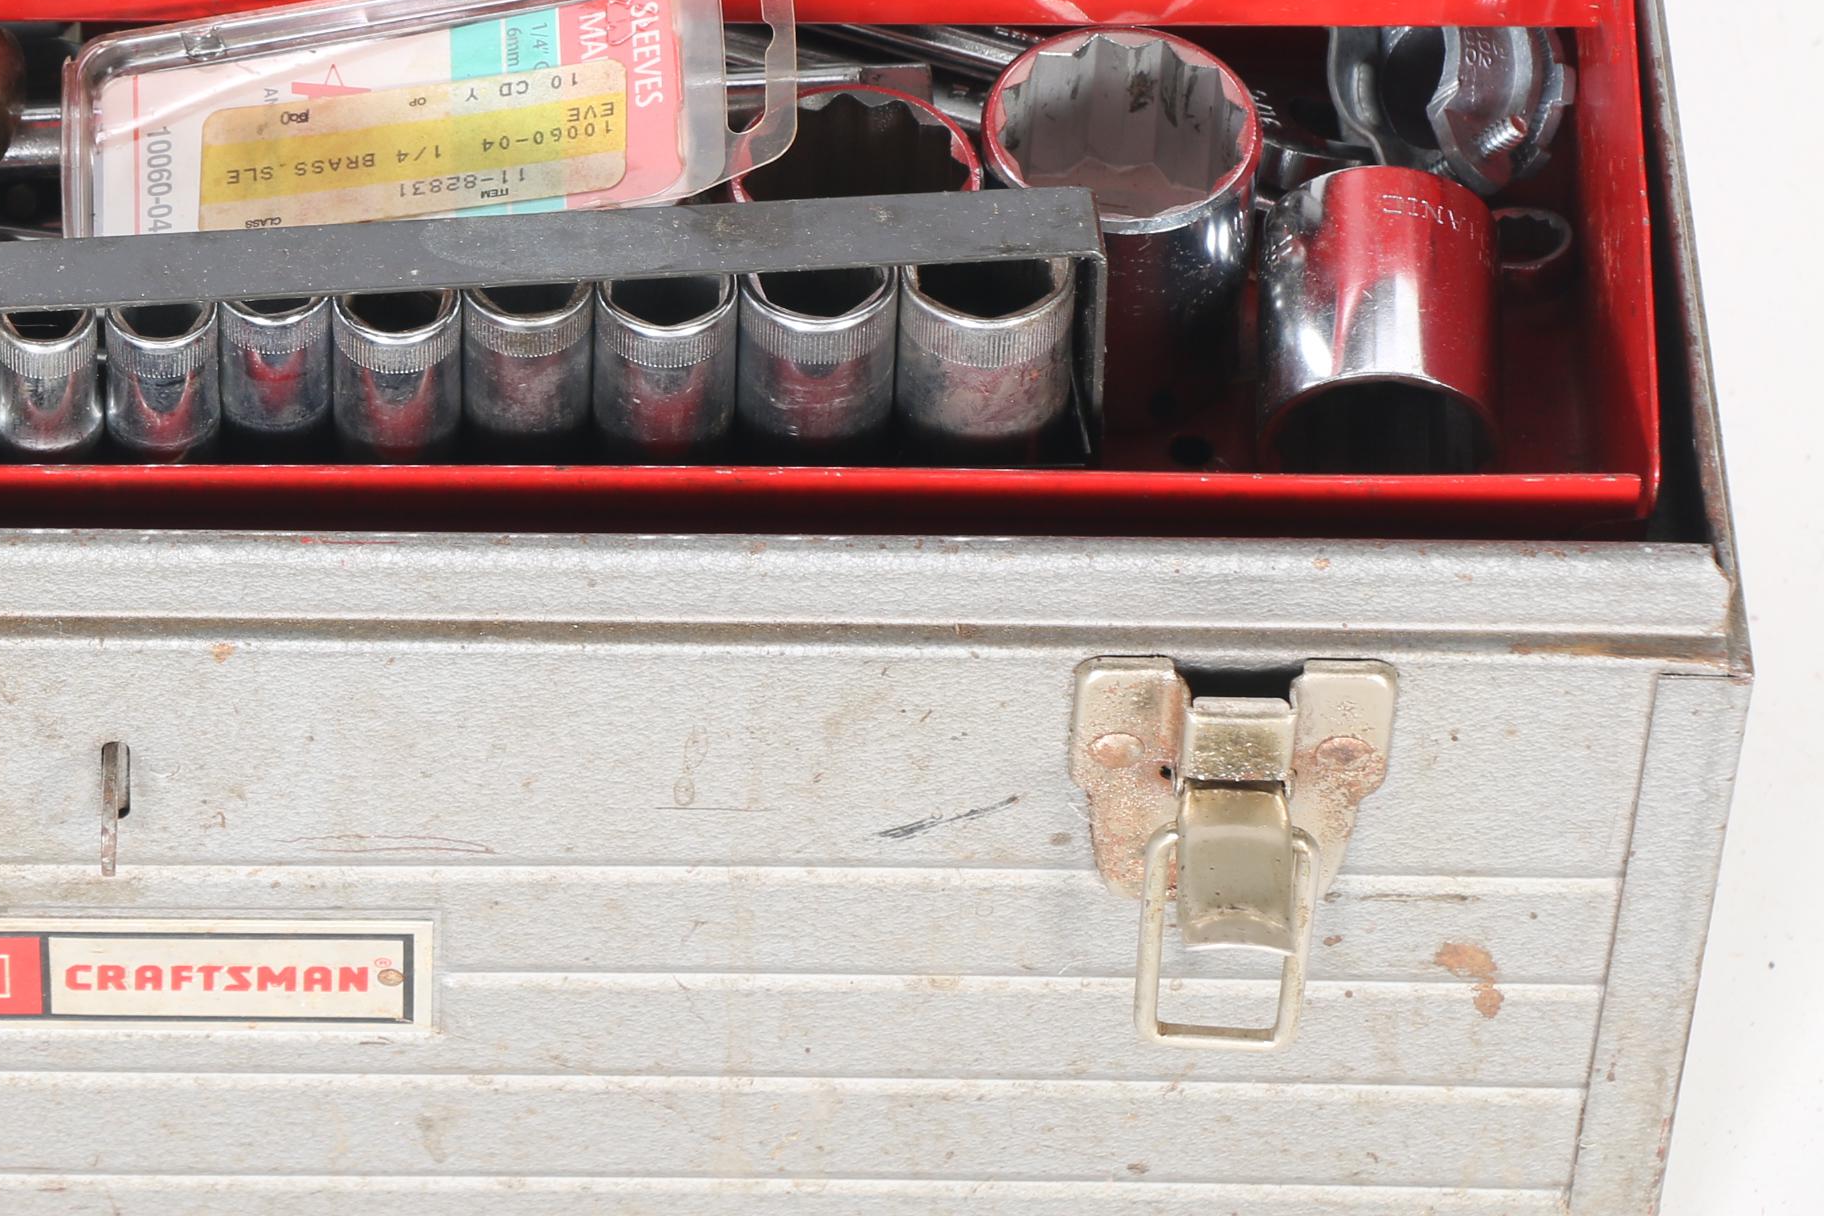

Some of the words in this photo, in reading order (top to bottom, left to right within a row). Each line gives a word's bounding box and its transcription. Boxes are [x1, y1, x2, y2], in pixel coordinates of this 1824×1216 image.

[506, 27, 522, 67] 6mm
[630, 0, 664, 108] SLEEVES
[499, 80, 529, 97] CD
[551, 72, 578, 89] 10
[408, 96, 427, 107] OP
[465, 87, 479, 103] Y
[567, 101, 615, 122] EVE
[482, 120, 613, 153] 10060-04
[294, 152, 376, 176] BRASS
[396, 145, 442, 164] 1/4
[146, 125, 173, 233] 10060-04
[226, 166, 274, 185] SLE
[399, 167, 526, 197] 11-82831
[480, 187, 509, 200] ITEM
[245, 216, 282, 228] CLASS
[64, 964, 369, 992] CRAFTSMAN
